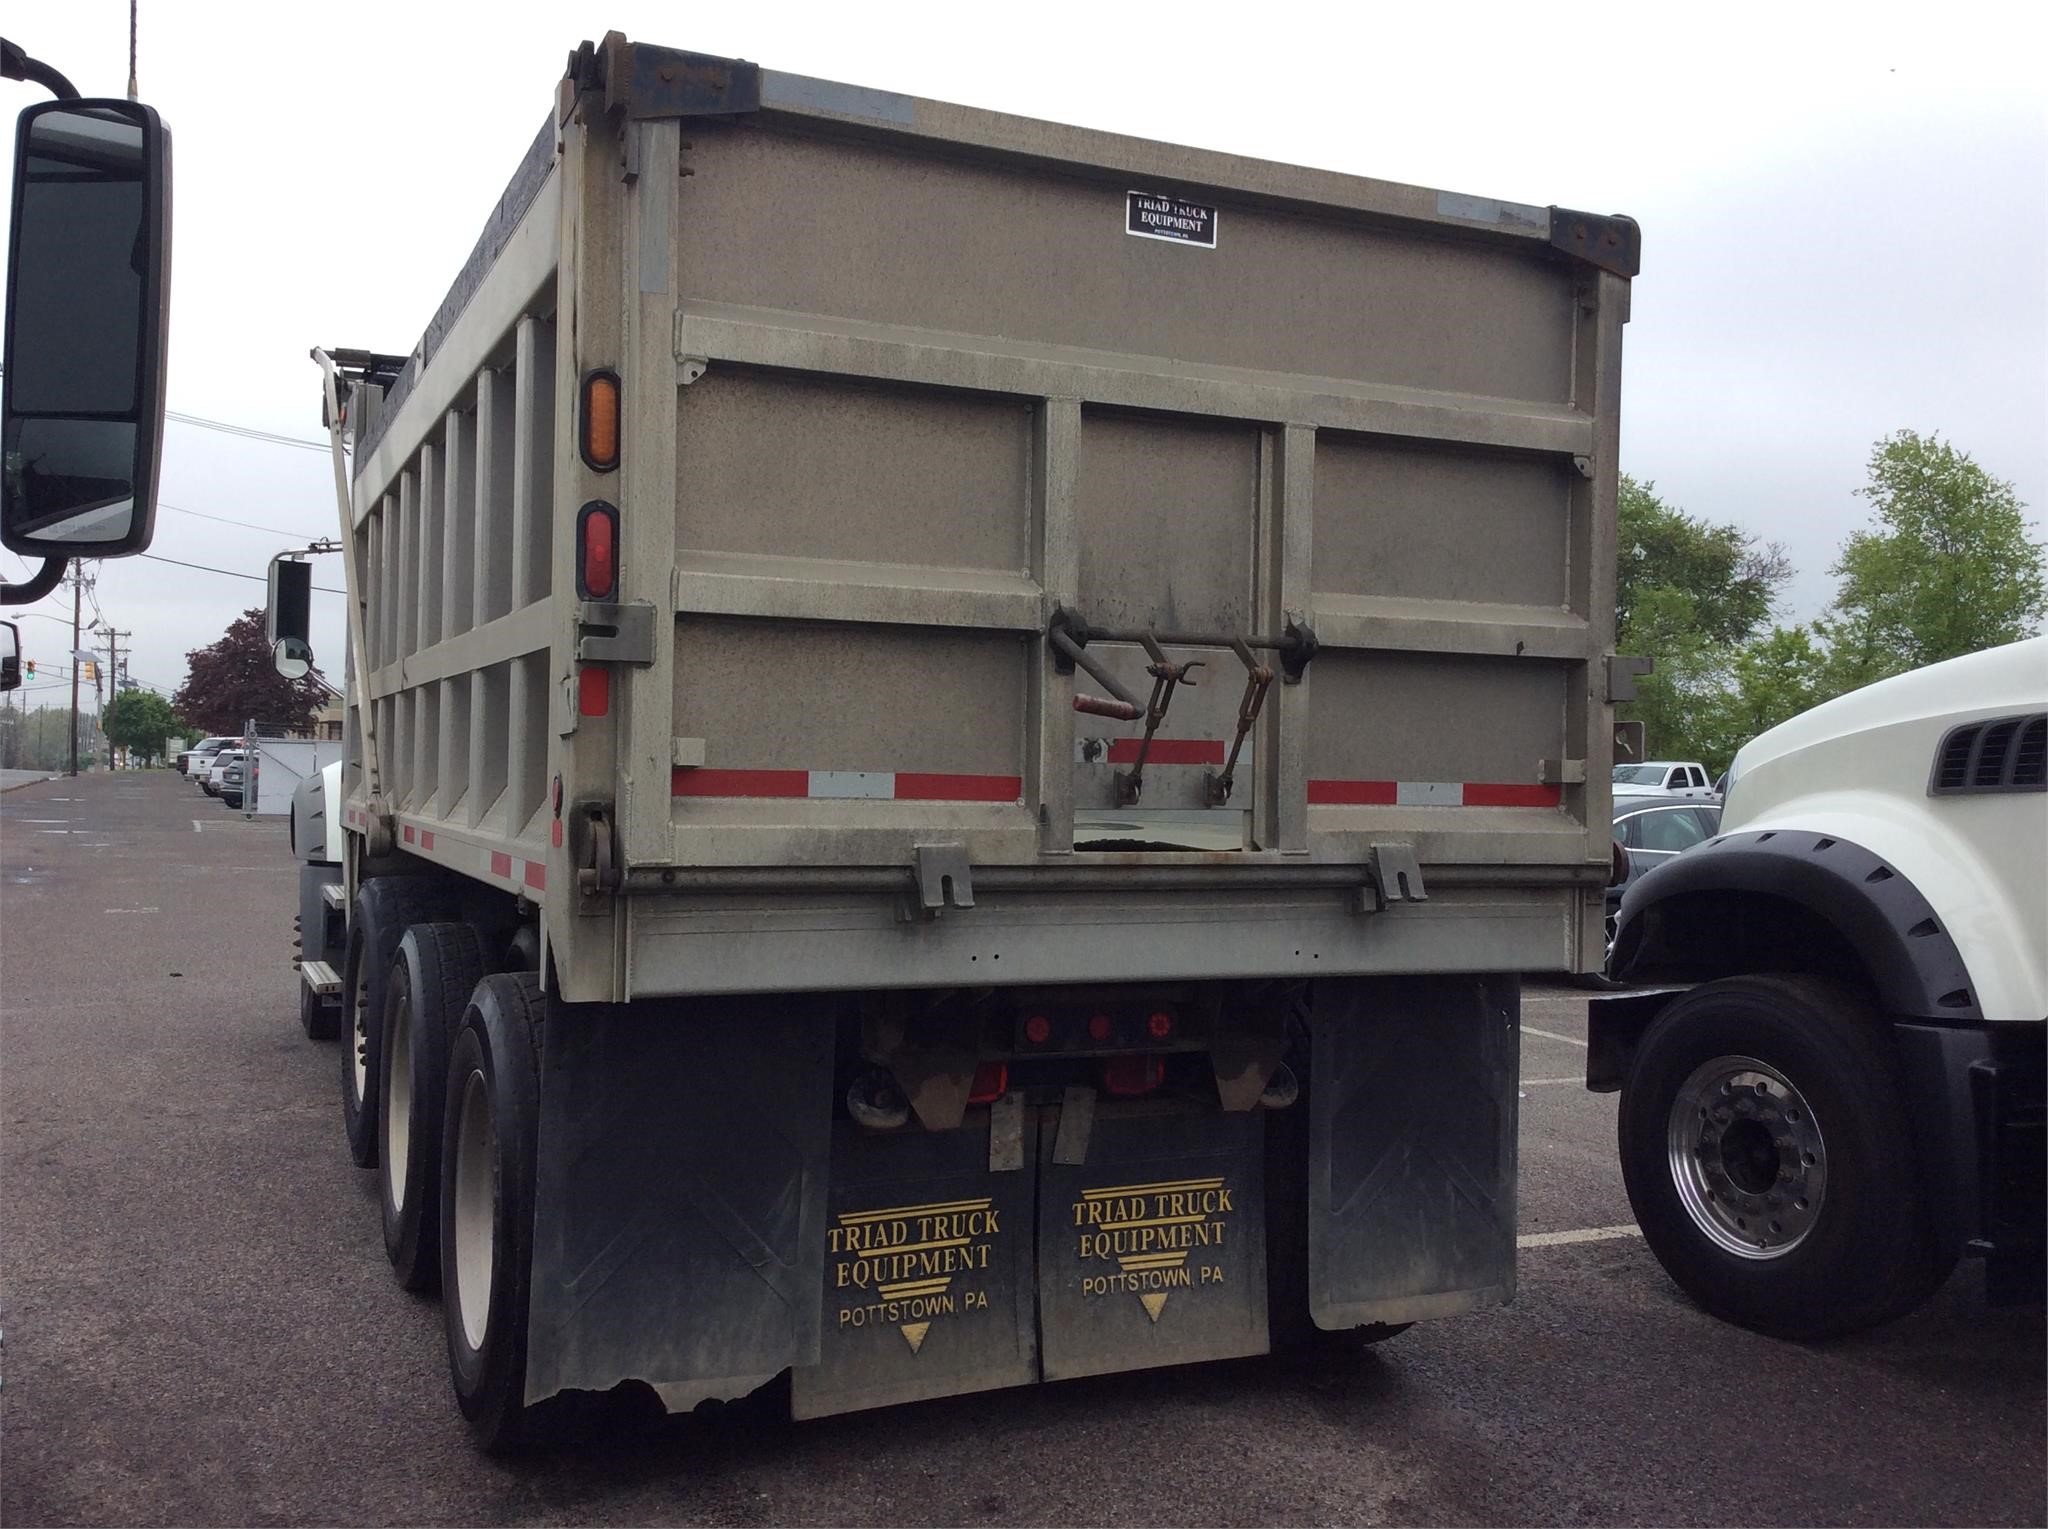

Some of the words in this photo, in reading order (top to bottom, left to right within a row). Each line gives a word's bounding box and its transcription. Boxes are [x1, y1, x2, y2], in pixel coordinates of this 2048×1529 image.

[1137, 198, 1169, 212] TRIAD
[1141, 211, 1203, 232] EQUIPMENT
[1072, 1197, 1146, 1226] TRIAD
[1155, 1189, 1233, 1217] TRUCK
[828, 1221, 907, 1253] TRIAD
[917, 1210, 1000, 1241] TRUCK
[1080, 1221, 1226, 1260] EQUIPMENT
[837, 1244, 992, 1289] EQUIPMENT
[1201, 1266, 1224, 1284] PA
[965, 1291, 988, 1311] PA
